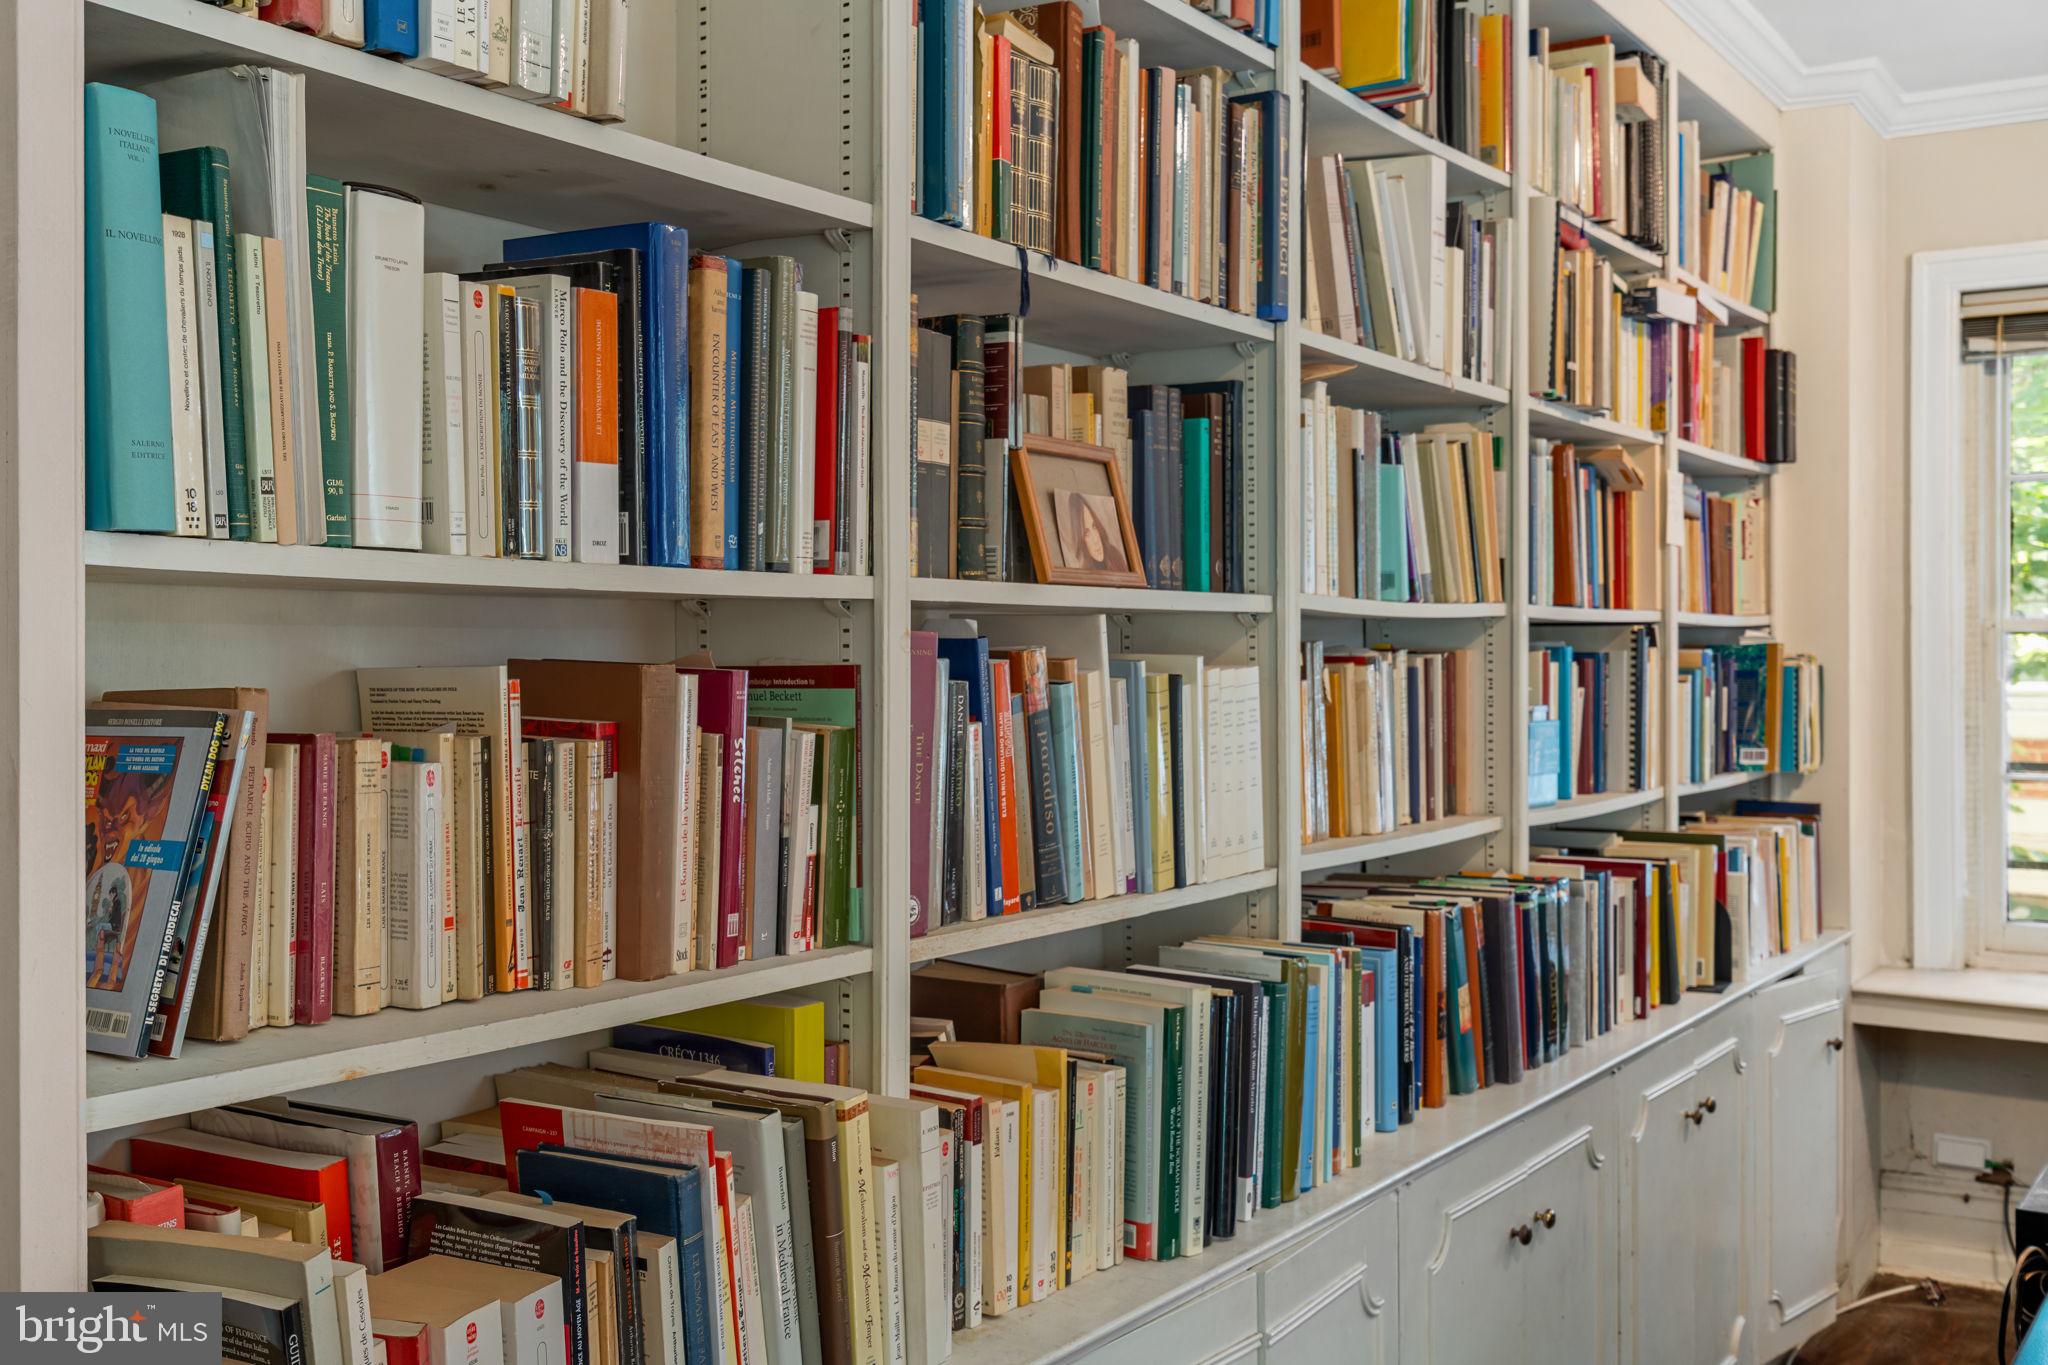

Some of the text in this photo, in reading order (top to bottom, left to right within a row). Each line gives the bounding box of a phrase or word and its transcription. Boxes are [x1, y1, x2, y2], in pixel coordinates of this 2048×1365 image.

[105, 229, 115, 238] IL
[171, 230, 187, 239] 1928
[1280, 175, 1289, 276] PETRARCH
[227, 268, 235, 325] TESORETTO
[559, 289, 568, 526] Marco Polo and the Discovery of the World
[710, 334, 721, 513] ENCOUNTER OF EAST AND WEST
[730, 351, 738, 482] MEDIEVAL MULTILINGUALISM
[131, 439, 165, 448] SALERNO
[185, 488, 197, 498] 10
[186, 501, 198, 512] 18
[748, 690, 803, 702] nuel Beckett
[750, 678, 772, 687] mbridge
[773, 678, 809, 686] Introduction
[957, 695, 965, 735] DANTE
[201, 720, 225, 791] DYLAN DOG 190
[732, 737, 745, 804] Silence
[322, 782, 328, 795] DE
[1036, 729, 1055, 836] paradiso
[244, 821, 253, 852] SCIPIO
[683, 815, 689, 827] la
[682, 831, 689, 846] de
[515, 838, 524, 880] Renart
[680, 857, 688, 886] Roman
[680, 893, 687, 902] Le
[240, 902, 248, 936] AFRICA
[145, 900, 182, 1025] IL SEGRETO DI MORDECAI
[184, 970, 197, 1014] VENDETTE
[659, 1045, 721, 1065] CRÉCY 1346
[402, 1149, 411, 1188] BARNEY,
[858, 1178, 868, 1237] Medievalism
[1050, 1252, 1056, 1261] 10
[1050, 1263, 1056, 1274] 18
[777, 1223, 792, 1340] in Medieval France
[862, 1264, 872, 1311] Modernist
[894, 1295, 900, 1305] Le
[224, 1325, 235, 1334] OF
[357, 1288, 368, 1346] de Cessoles
[865, 1314, 874, 1348] Temper
[577, 1340, 583, 1350] AU
